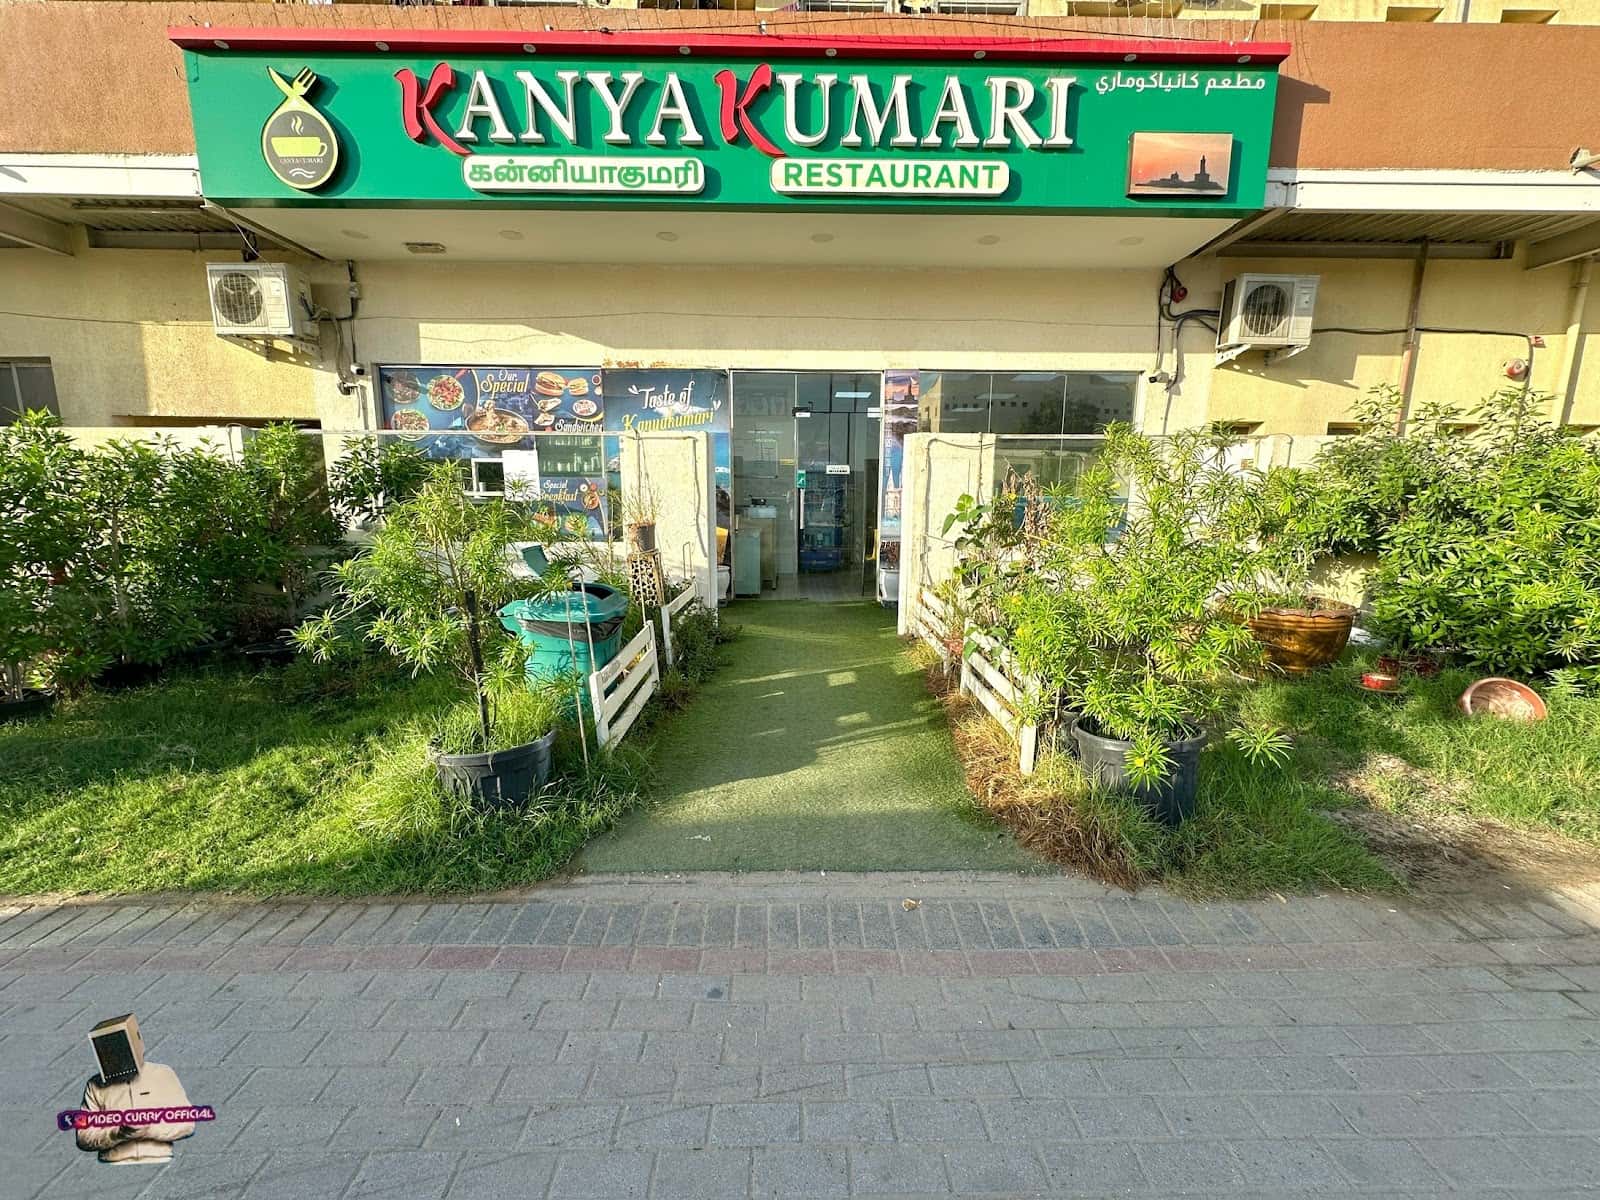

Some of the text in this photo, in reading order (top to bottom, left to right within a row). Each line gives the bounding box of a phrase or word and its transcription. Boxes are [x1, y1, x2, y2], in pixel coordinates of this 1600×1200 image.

[1095, 71, 1266, 97] مطعم كانياكوماري
[394, 62, 1077, 158] KANYA KUMARI
[468, 158, 701, 189] கன்னியாகுமரி
[783, 162, 1001, 189] RESTAURANT
[481, 373, 530, 399] Special
[639, 380, 696, 411] Taste of
